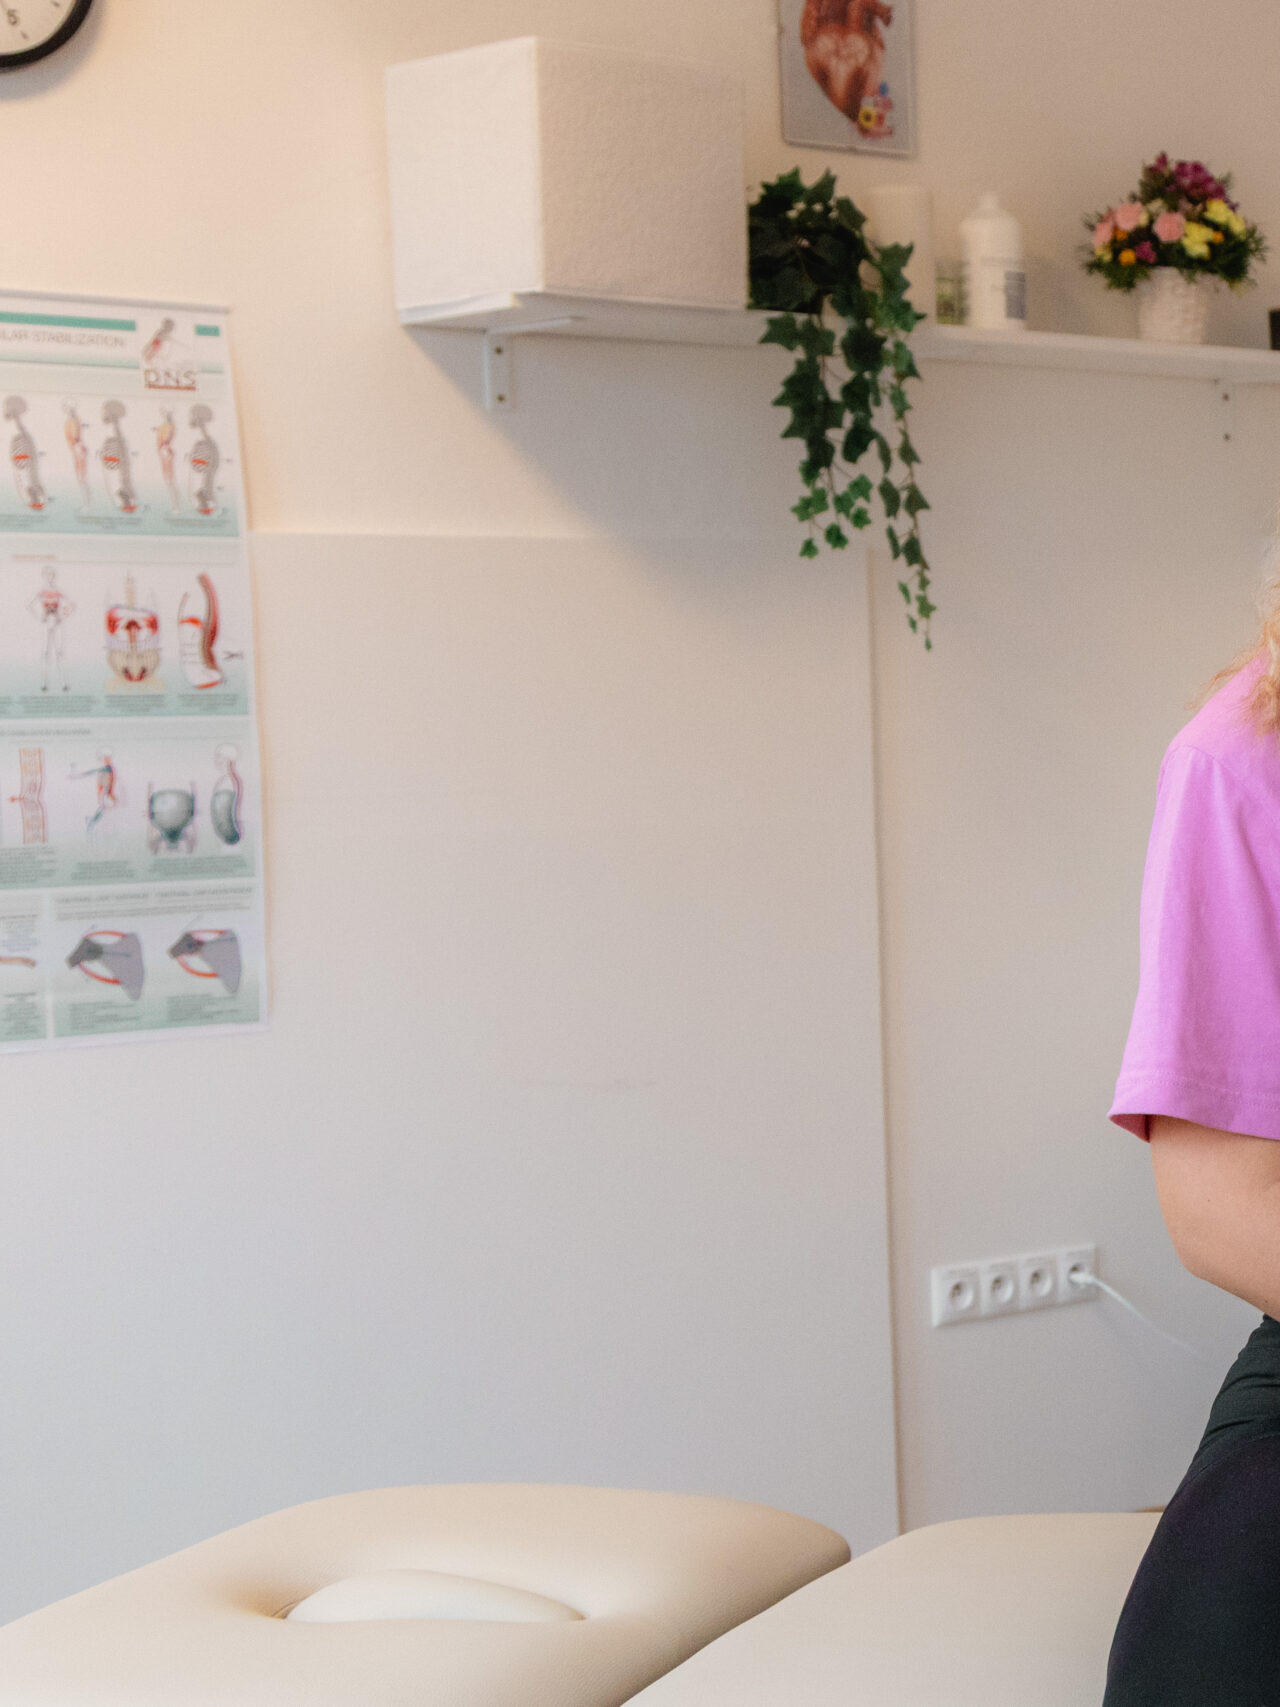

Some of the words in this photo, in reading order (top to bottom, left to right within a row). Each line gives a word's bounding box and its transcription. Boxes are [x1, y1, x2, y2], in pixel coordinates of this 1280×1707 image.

[7, 9, 19, 26] 5
[32, 331, 125, 347] STABILIZATION
[143, 369, 197, 387] DNS
